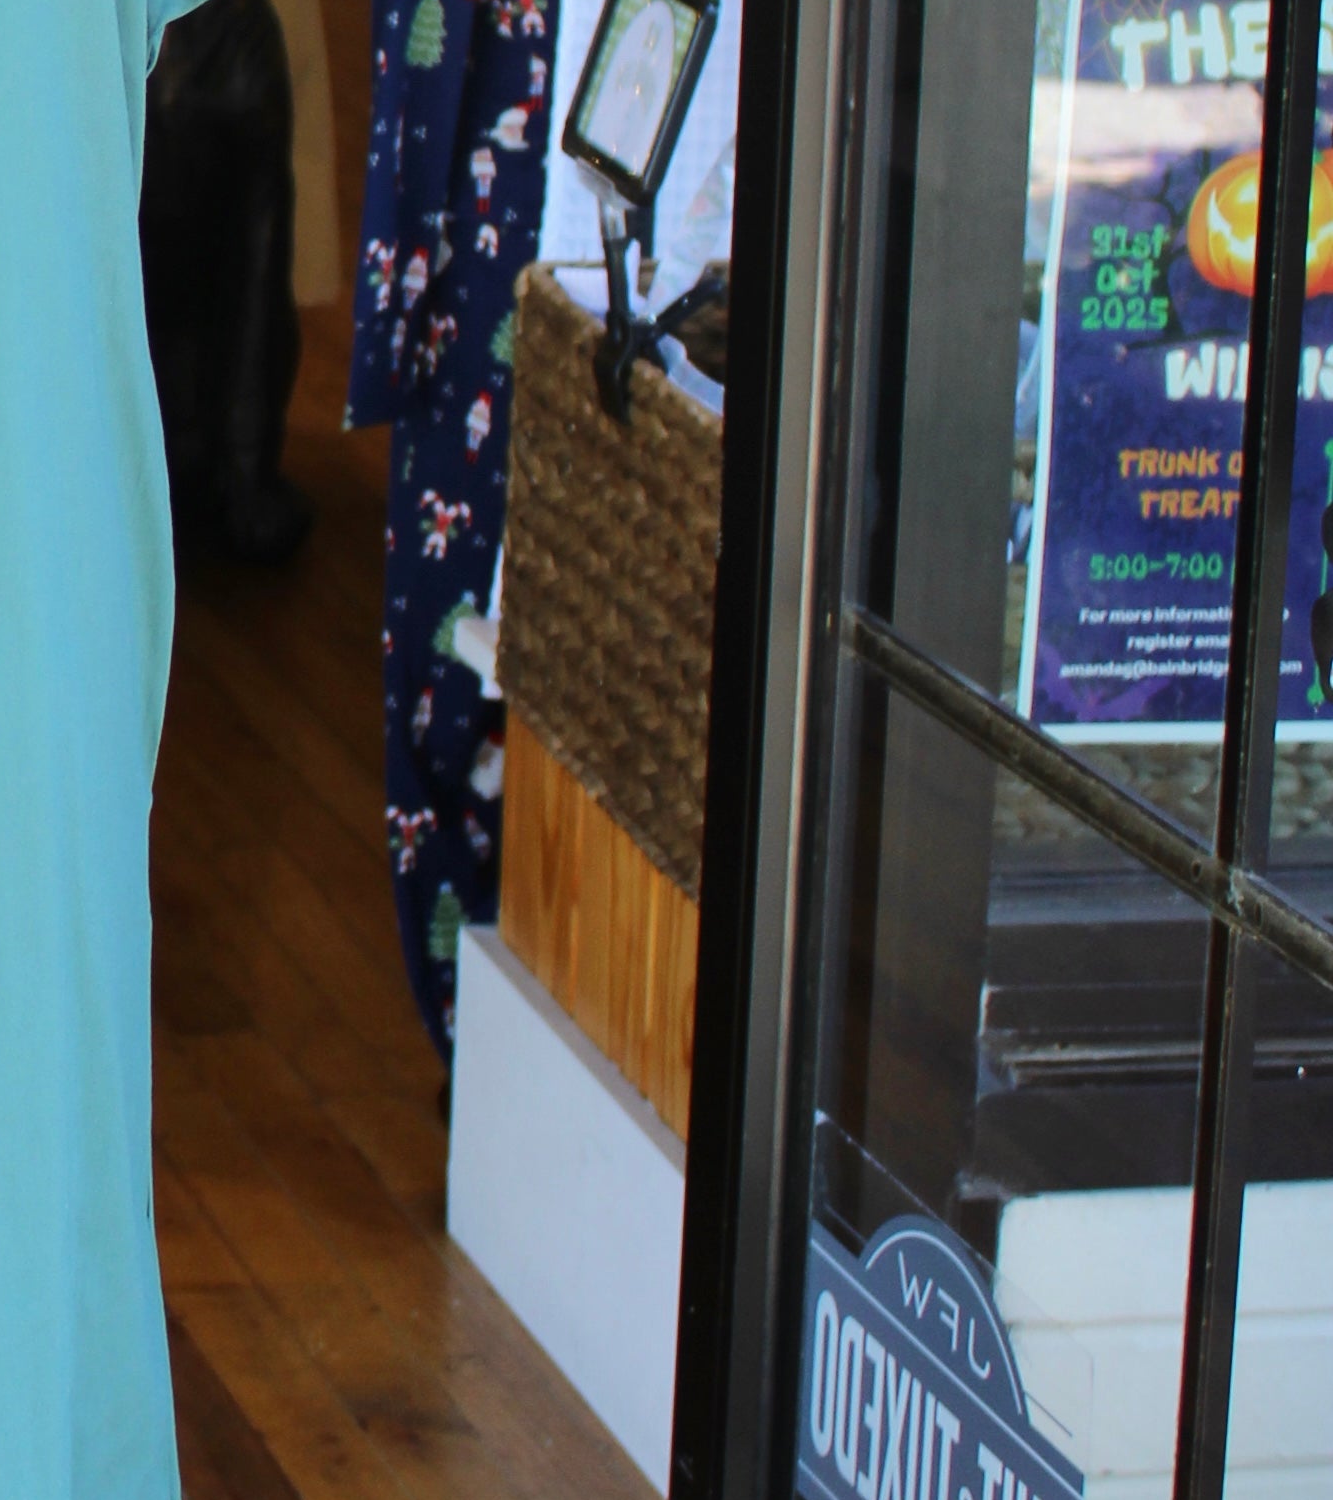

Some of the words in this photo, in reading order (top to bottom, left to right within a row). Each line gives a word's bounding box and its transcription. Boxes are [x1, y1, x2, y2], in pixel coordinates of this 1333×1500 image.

[1081, 297, 1169, 330] 2025
[1119, 446, 1222, 479] TRUNK
[1139, 487, 1242, 520] TREAT
[1079, 607, 1108, 625] For
[1108, 608, 1153, 624] more
[1154, 605, 1233, 624] informati
[1126, 632, 1192, 654] register
